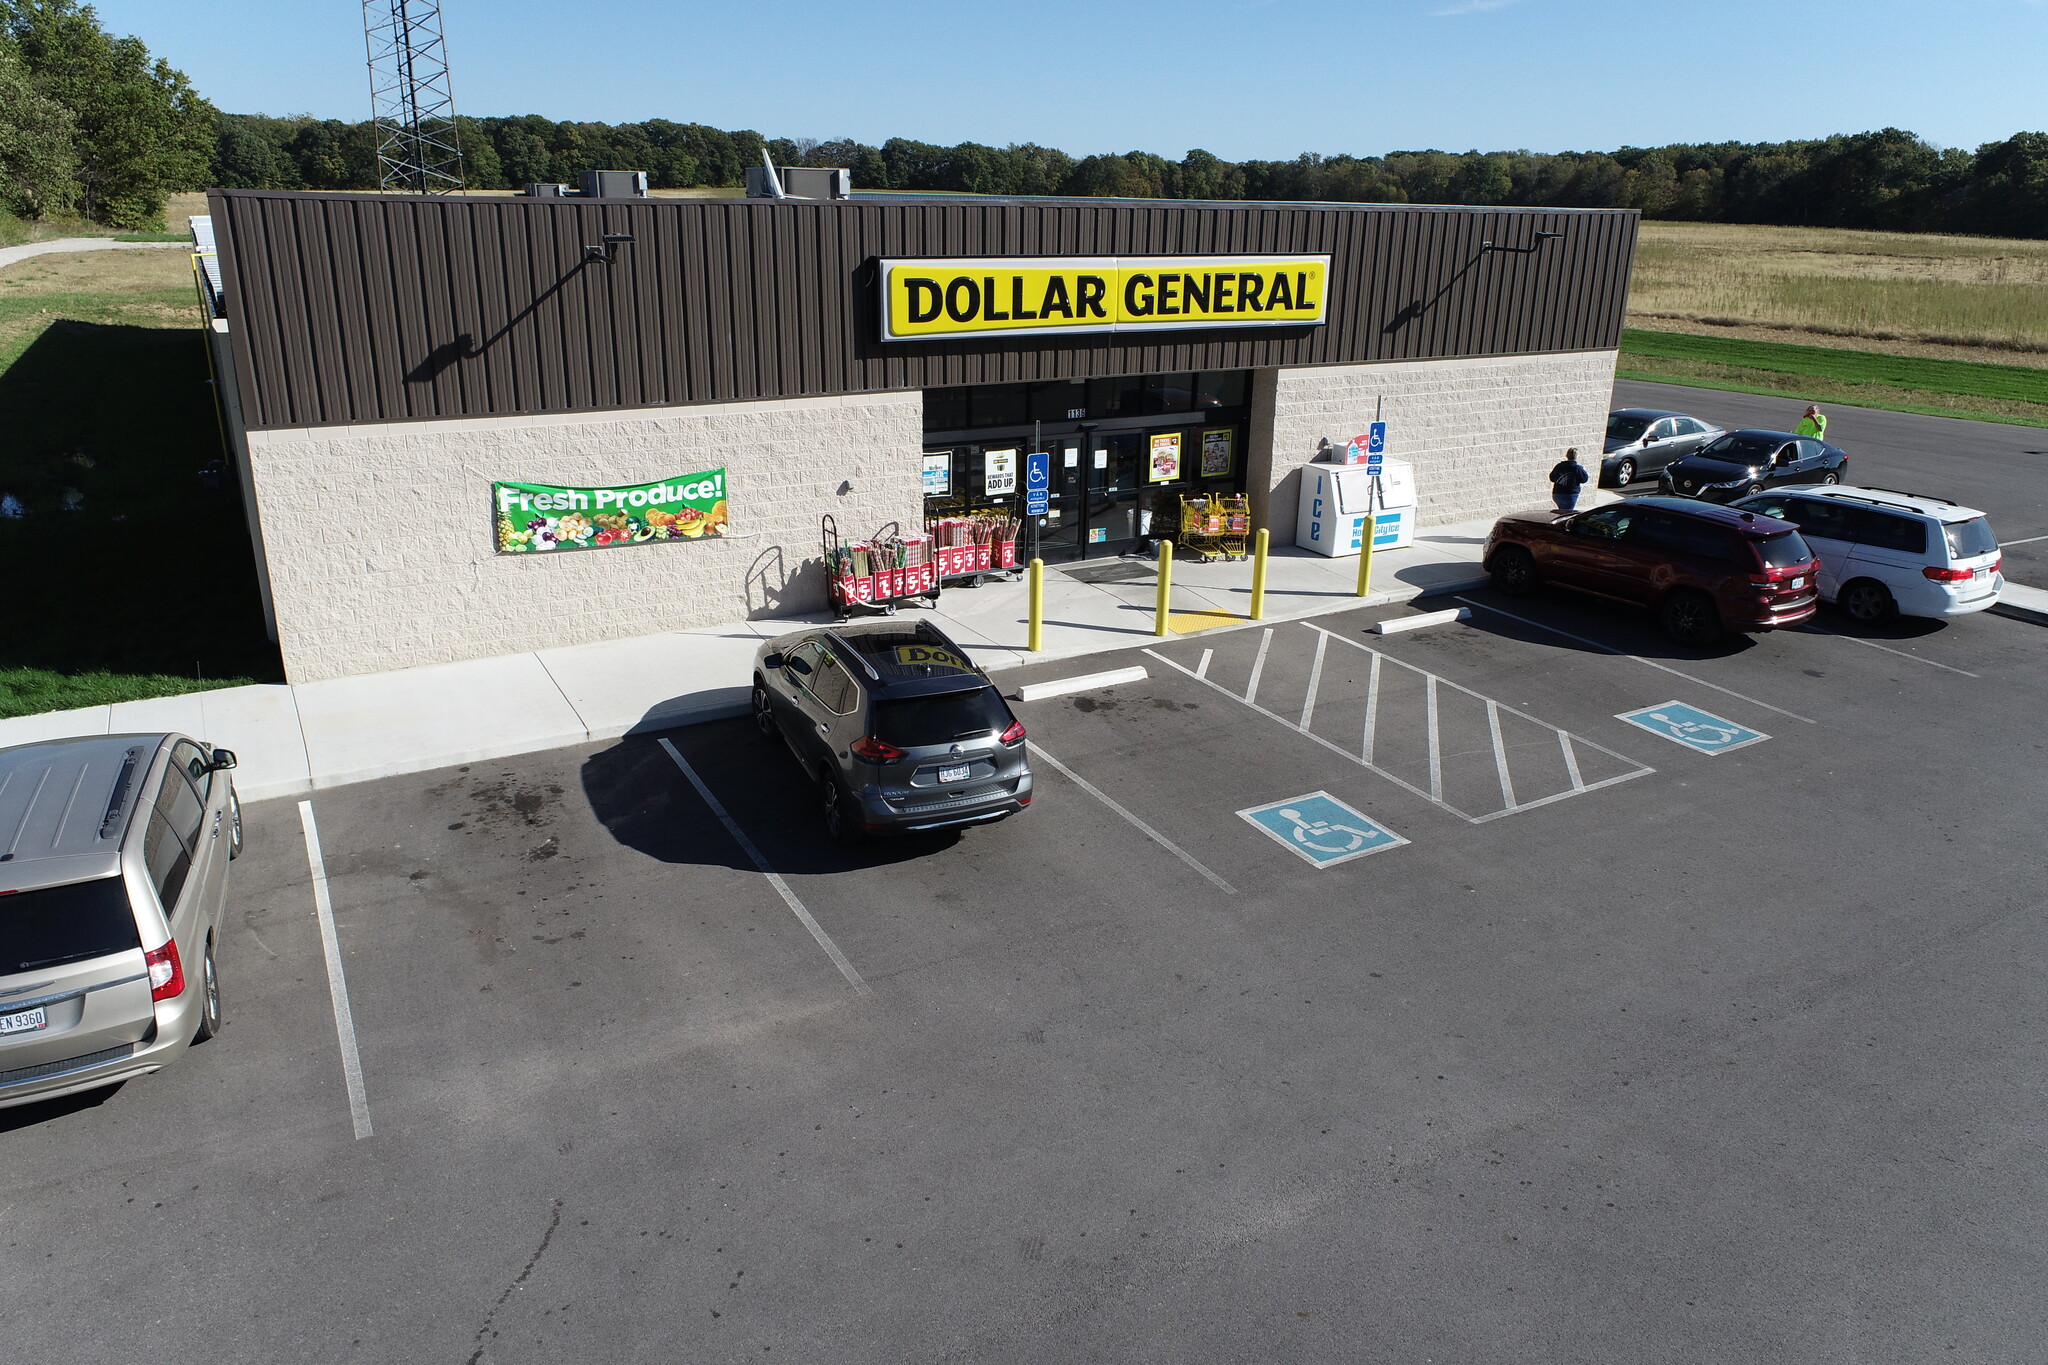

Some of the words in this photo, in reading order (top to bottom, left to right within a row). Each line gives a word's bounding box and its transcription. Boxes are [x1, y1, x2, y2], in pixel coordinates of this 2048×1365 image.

[904, 275, 1107, 323] DOLLAR
[1124, 271, 1316, 317] GENERAL
[987, 479, 1002, 489] ADD
[1003, 478, 1014, 487] UP.
[500, 487, 588, 512] Fresh
[594, 474, 722, 509] Produce!
[1374, 525, 1387, 536] City
[1388, 523, 1400, 532] Ice
[16, 1011, 42, 1027] 9360
